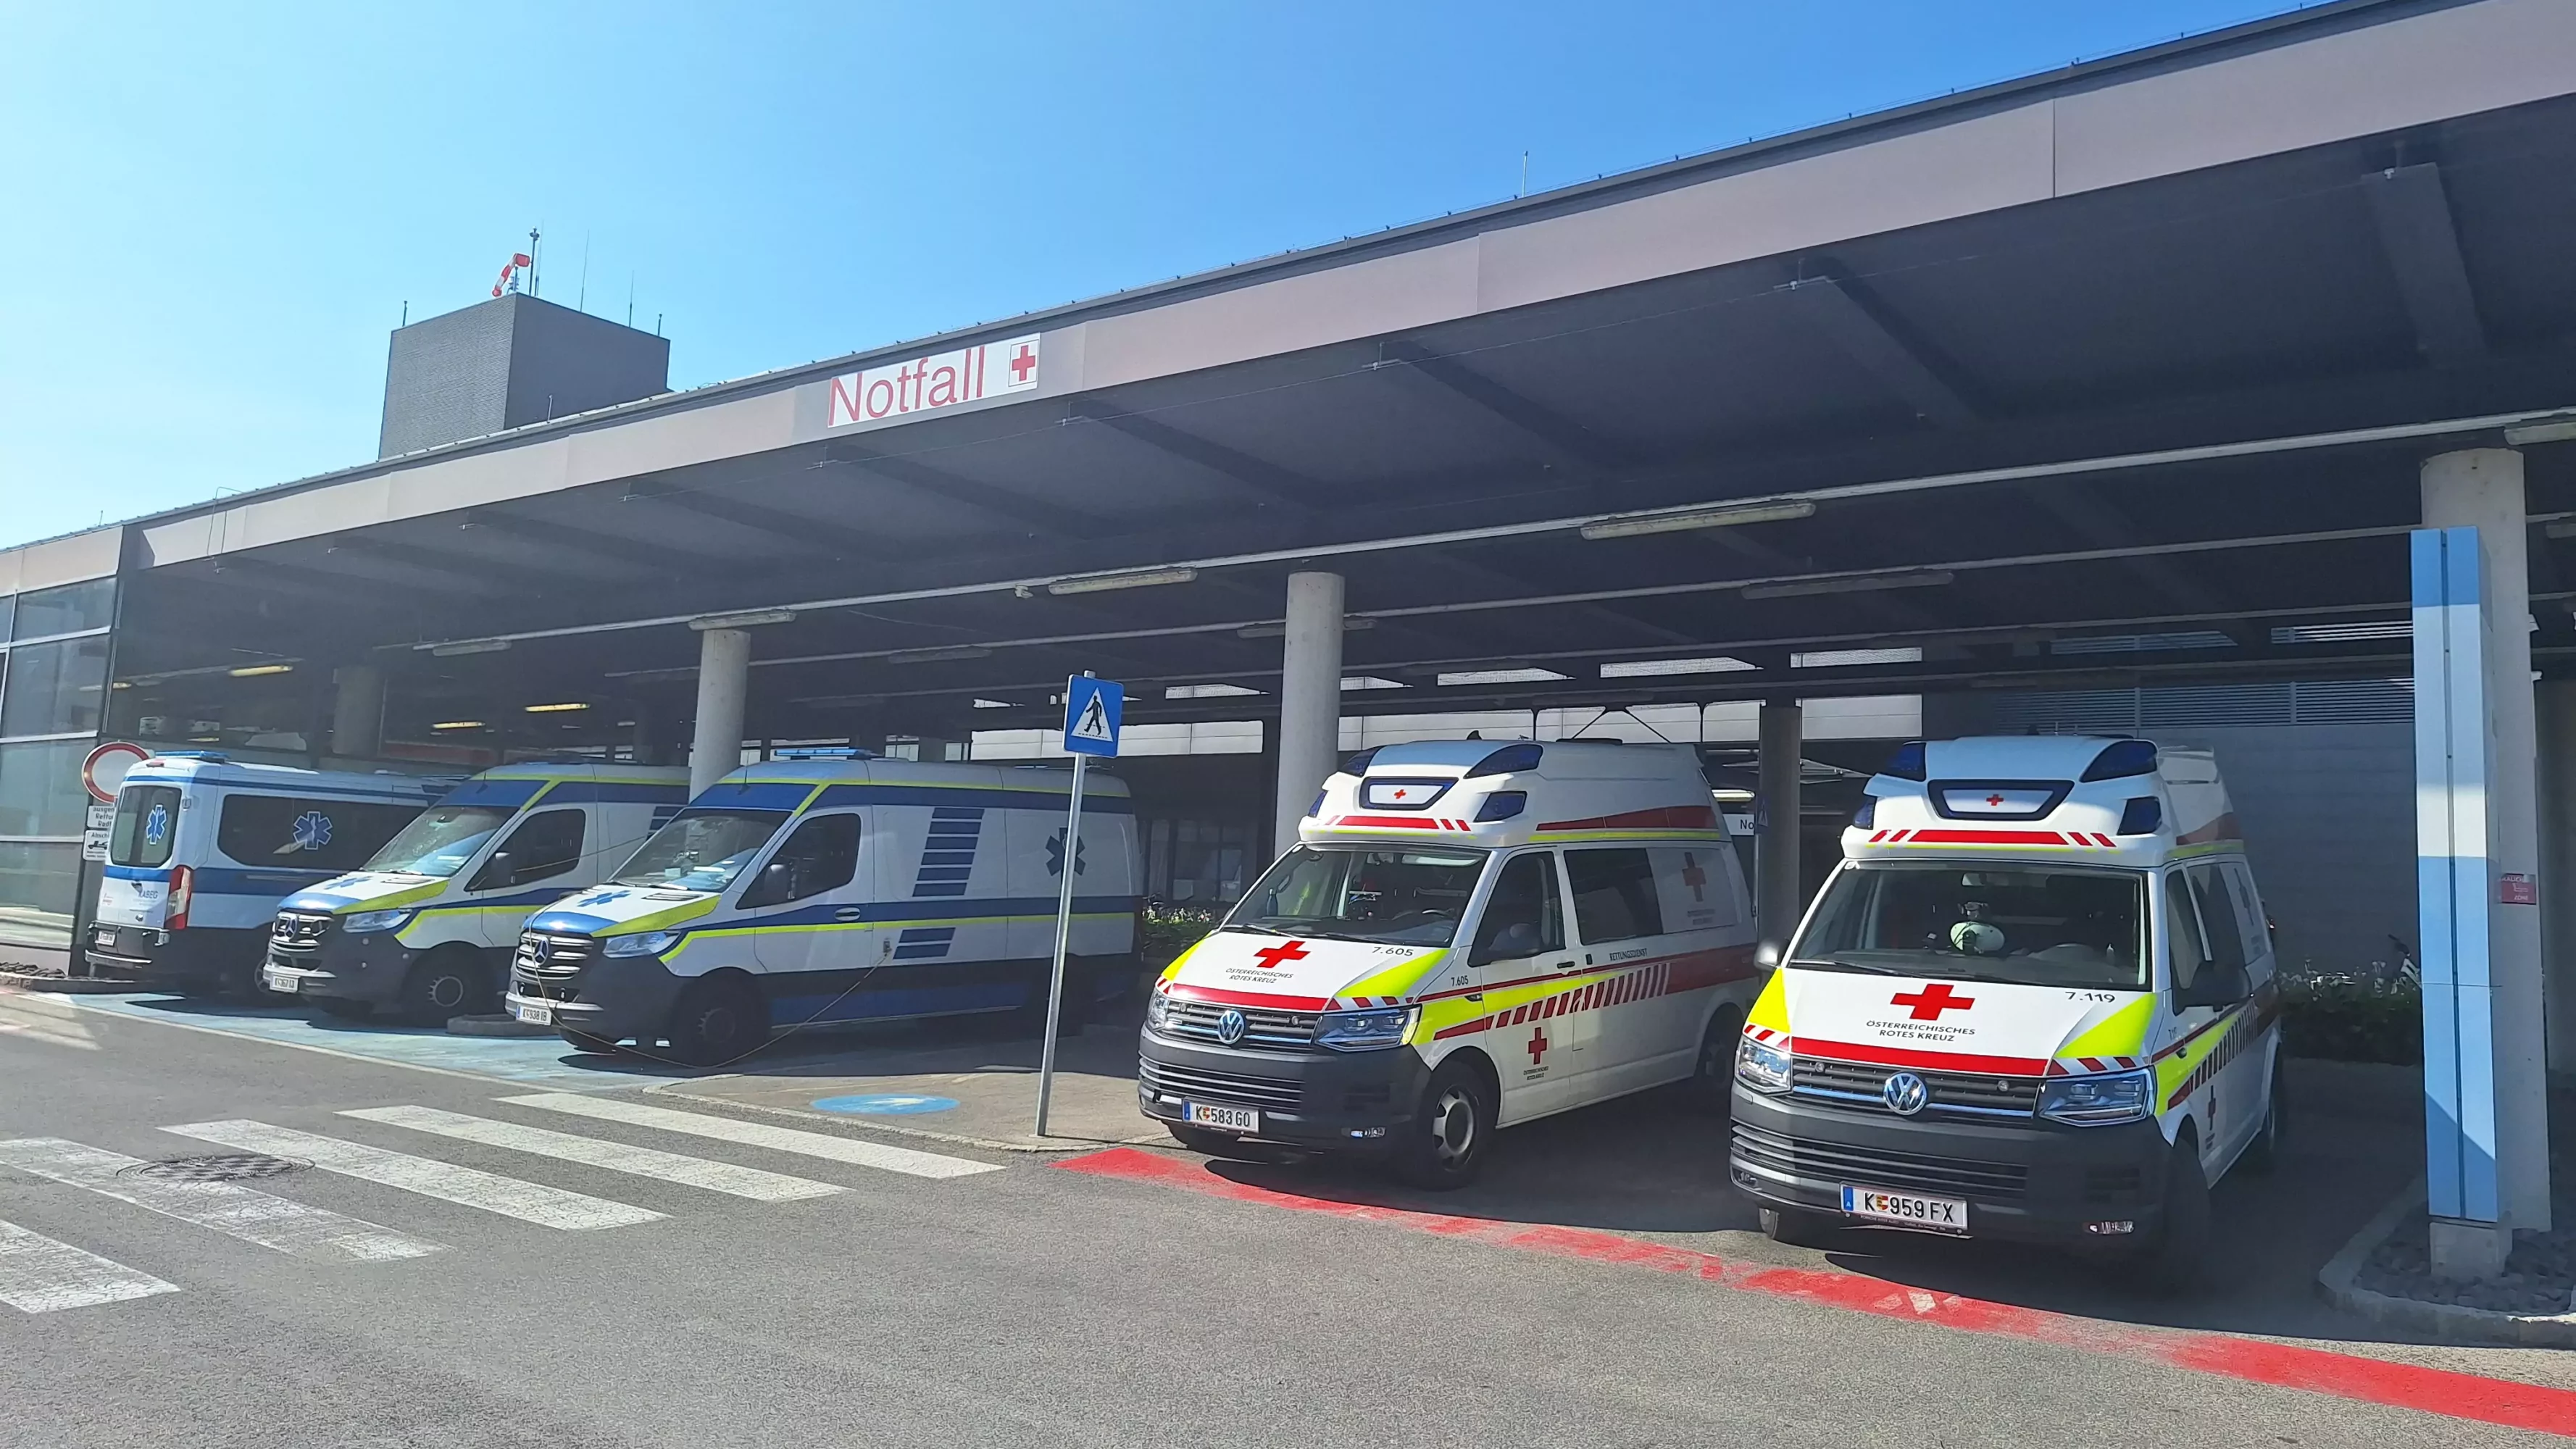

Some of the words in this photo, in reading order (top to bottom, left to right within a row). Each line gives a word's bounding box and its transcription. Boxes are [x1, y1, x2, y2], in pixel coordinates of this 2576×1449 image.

[828, 345, 985, 427] Notfall
[1740, 819, 1754, 830] No
[1371, 946, 1414, 956] 7.605
[1225, 968, 1293, 979] ÖSTERREICHISCHES
[1451, 975, 1469, 987] 7.605
[2064, 991, 2116, 1003] 7.119
[1866, 1020, 1975, 1035] ÖSTERREICHISCHES
[1879, 1030, 1914, 1039] ROTES
[1917, 1032, 1955, 1042] KREUZ
[1235, 1111, 1250, 1127] GO
[1890, 1197, 1925, 1218] 959
[1930, 1202, 1954, 1222] FX
